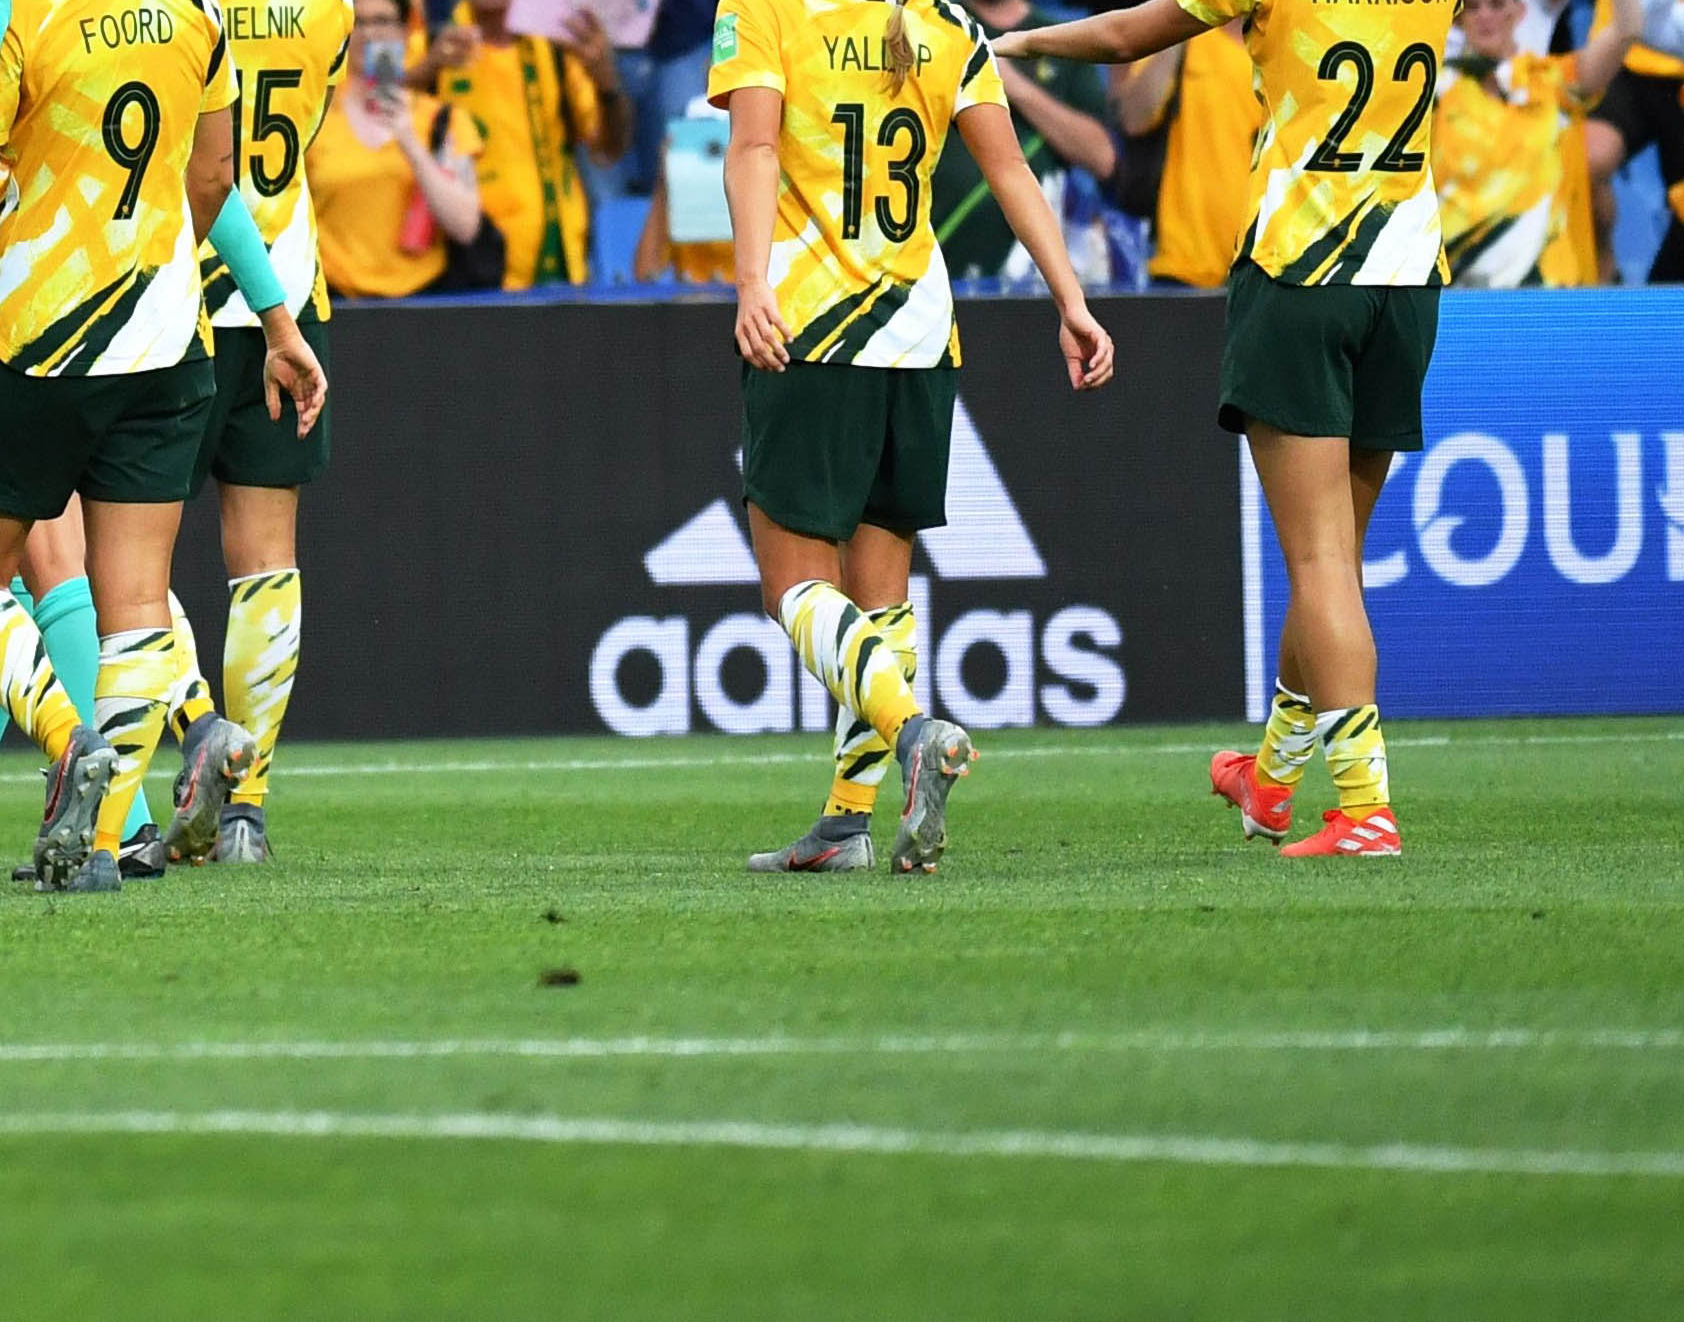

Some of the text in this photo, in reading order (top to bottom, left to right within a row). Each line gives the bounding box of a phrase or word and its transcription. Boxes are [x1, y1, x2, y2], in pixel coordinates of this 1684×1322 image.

[78, 7, 174, 55] FOORD
[226, 5, 307, 41] IELNIK
[822, 34, 933, 78] YALLP
[101, 80, 161, 221] 9
[830, 103, 927, 243] 13
[1303, 40, 1438, 173] 22
[589, 576, 1126, 737] adas
